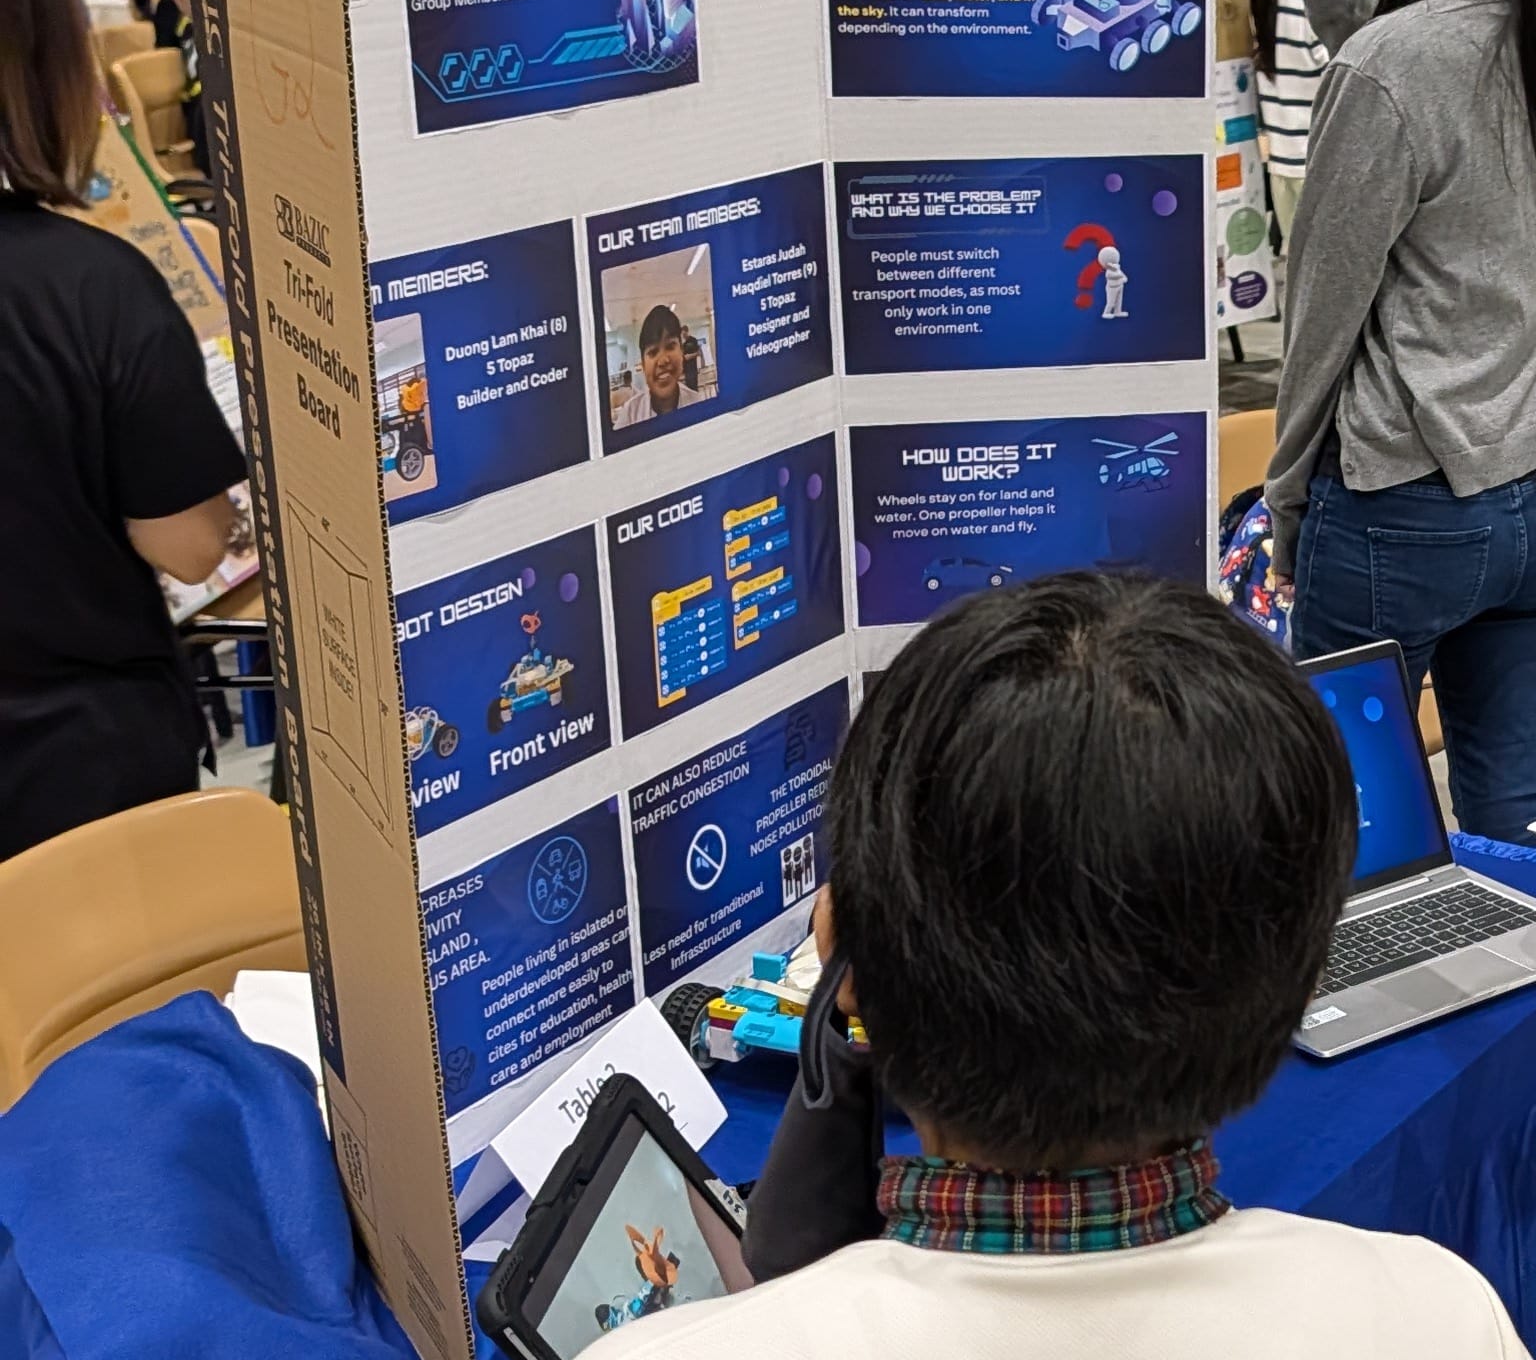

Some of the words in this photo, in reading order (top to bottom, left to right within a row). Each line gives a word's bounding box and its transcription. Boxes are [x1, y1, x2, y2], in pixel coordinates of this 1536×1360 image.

[837, 5, 860, 17] the
[861, 5, 888, 19] sky.
[889, 6, 899, 17] It
[901, 7, 925, 17] can
[926, 6, 989, 18] transform
[837, 22, 906, 36] depending
[908, 24, 925, 34] on
[926, 22, 949, 34] the
[950, 23, 1032, 35] environment.
[851, 193, 893, 206] WHAT
[898, 192, 920, 204] IS
[923, 191, 955, 203] THE
[959, 190, 1041, 202] PROBLEM?
[852, 206, 884, 218] AND
[888, 205, 920, 217] WHY
[924, 204, 946, 216] WE
[950, 203, 1012, 215] CHOOSE
[1016, 202, 1036, 214] IT
[294, 205, 330, 255] BAZIC
[598, 228, 634, 253] OUR
[638, 216, 683, 242] TEAM
[686, 197, 761, 231] MEMBERS:
[742, 253, 777, 273] Estaras
[778, 243, 806, 262] Judah
[871, 249, 918, 265] People
[920, 249, 954, 261] must
[956, 247, 999, 261] switch
[388, 260, 489, 302] MEMBERS:
[876, 269, 935, 282] between
[937, 266, 996, 280] different
[284, 259, 334, 327] Tri-Fold
[760, 297, 767, 311] 5
[766, 291, 796, 309] Topaz
[852, 287, 917, 302] transport
[919, 285, 967, 299] modes,
[969, 286, 985, 297] as
[987, 284, 1021, 296] most
[748, 314, 792, 337] Designer
[792, 305, 810, 323] and
[884, 305, 914, 321] only
[916, 303, 949, 317] work
[951, 303, 964, 315] in
[966, 304, 991, 315] one
[445, 340, 490, 362] Duong
[491, 332, 519, 350] Lam
[520, 319, 548, 342] Khai
[550, 315, 567, 336] (8)
[746, 330, 810, 359] Videographer
[894, 322, 983, 336] environment.
[267, 299, 361, 403] Presentation
[486, 360, 496, 376] 5
[496, 353, 535, 373] Topaz
[457, 386, 504, 410] Builder
[505, 375, 529, 396] and
[530, 367, 568, 388] Coder
[297, 372, 341, 441] Board
[902, 448, 950, 466] HOW
[957, 445, 1019, 463] DOES
[1026, 443, 1057, 460] IT
[212, 100, 250, 320] Tri-Fold
[241, 336, 290, 691] Presentation
[283, 705, 312, 868] Board
[942, 463, 1019, 482] WORK?
[877, 493, 927, 506] Wheels
[928, 493, 957, 505] stay
[958, 493, 976, 502] on
[978, 489, 998, 501] for
[999, 487, 1028, 500] land
[1030, 487, 1055, 499] and
[617, 514, 654, 543] OUR
[657, 495, 703, 528] CODE
[874, 512, 916, 523] water.
[918, 509, 946, 521] One
[948, 506, 1007, 521] propeller
[1009, 504, 1044, 517] helps
[1046, 503, 1056, 514] it
[892, 528, 929, 539] move
[930, 527, 948, 537] on
[950, 524, 989, 535] water
[990, 521, 1015, 533] and
[1017, 520, 1037, 534] fly.
[440, 578, 523, 626] DESIGN
[413, 770, 461, 809] view
[490, 733, 546, 776] Front
[548, 713, 594, 748] view
[633, 793, 644, 810] IT
[645, 779, 670, 803] CAN
[671, 764, 701, 790] ALSO
[702, 740, 747, 773] REDUCE
[770, 782, 788, 802] THE
[788, 758, 833, 791] TOROIDAL
[632, 799, 678, 834] TRAFFIC
[680, 762, 749, 809] CONGESTION
[756, 792, 807, 833] PROPELLER
[750, 829, 778, 857] NOISE
[643, 943, 667, 965] Less
[667, 924, 693, 951] need
[693, 917, 709, 934] for
[710, 881, 764, 925] tranditional
[670, 919, 742, 970] Infrasstructure
[450, 950, 491, 981] AREA.
[490, 1063, 518, 1086] care
[520, 1045, 542, 1070] and
[544, 1005, 612, 1055] employment
